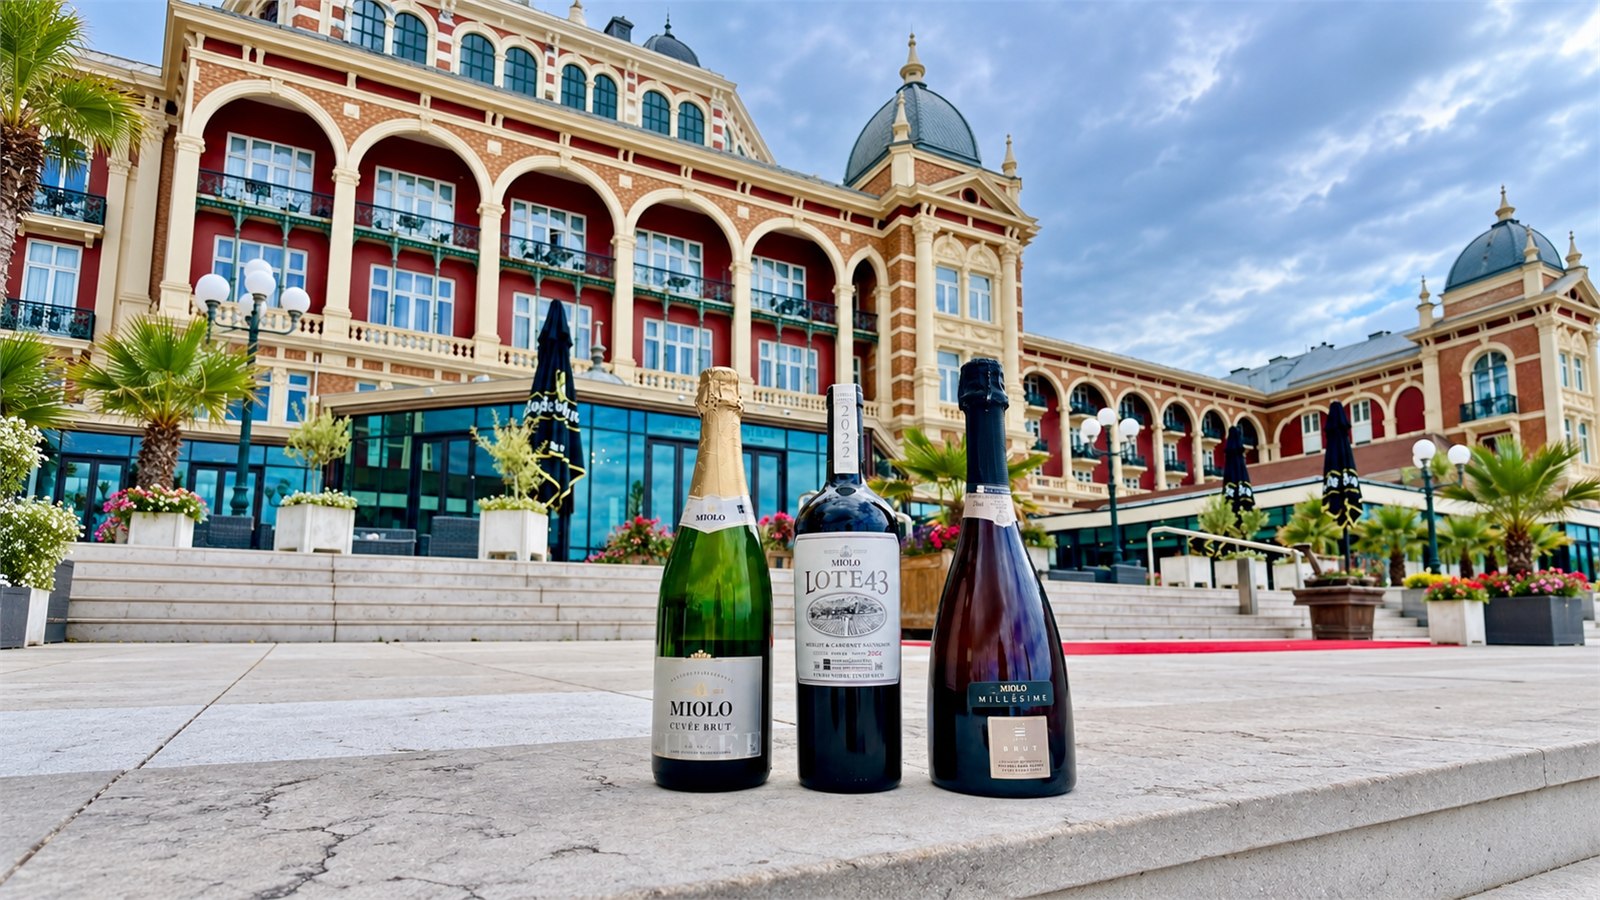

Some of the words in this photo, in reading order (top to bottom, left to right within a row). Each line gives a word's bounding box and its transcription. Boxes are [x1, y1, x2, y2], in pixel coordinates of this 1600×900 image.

[841, 405, 850, 458] 2022
[832, 559, 860, 567] MIOLO
[1000, 684, 1027, 693] MIOLO
[670, 700, 733, 717] MIOLO
[669, 721, 700, 731] CUVÉE
[703, 722, 732, 731] BRUT
